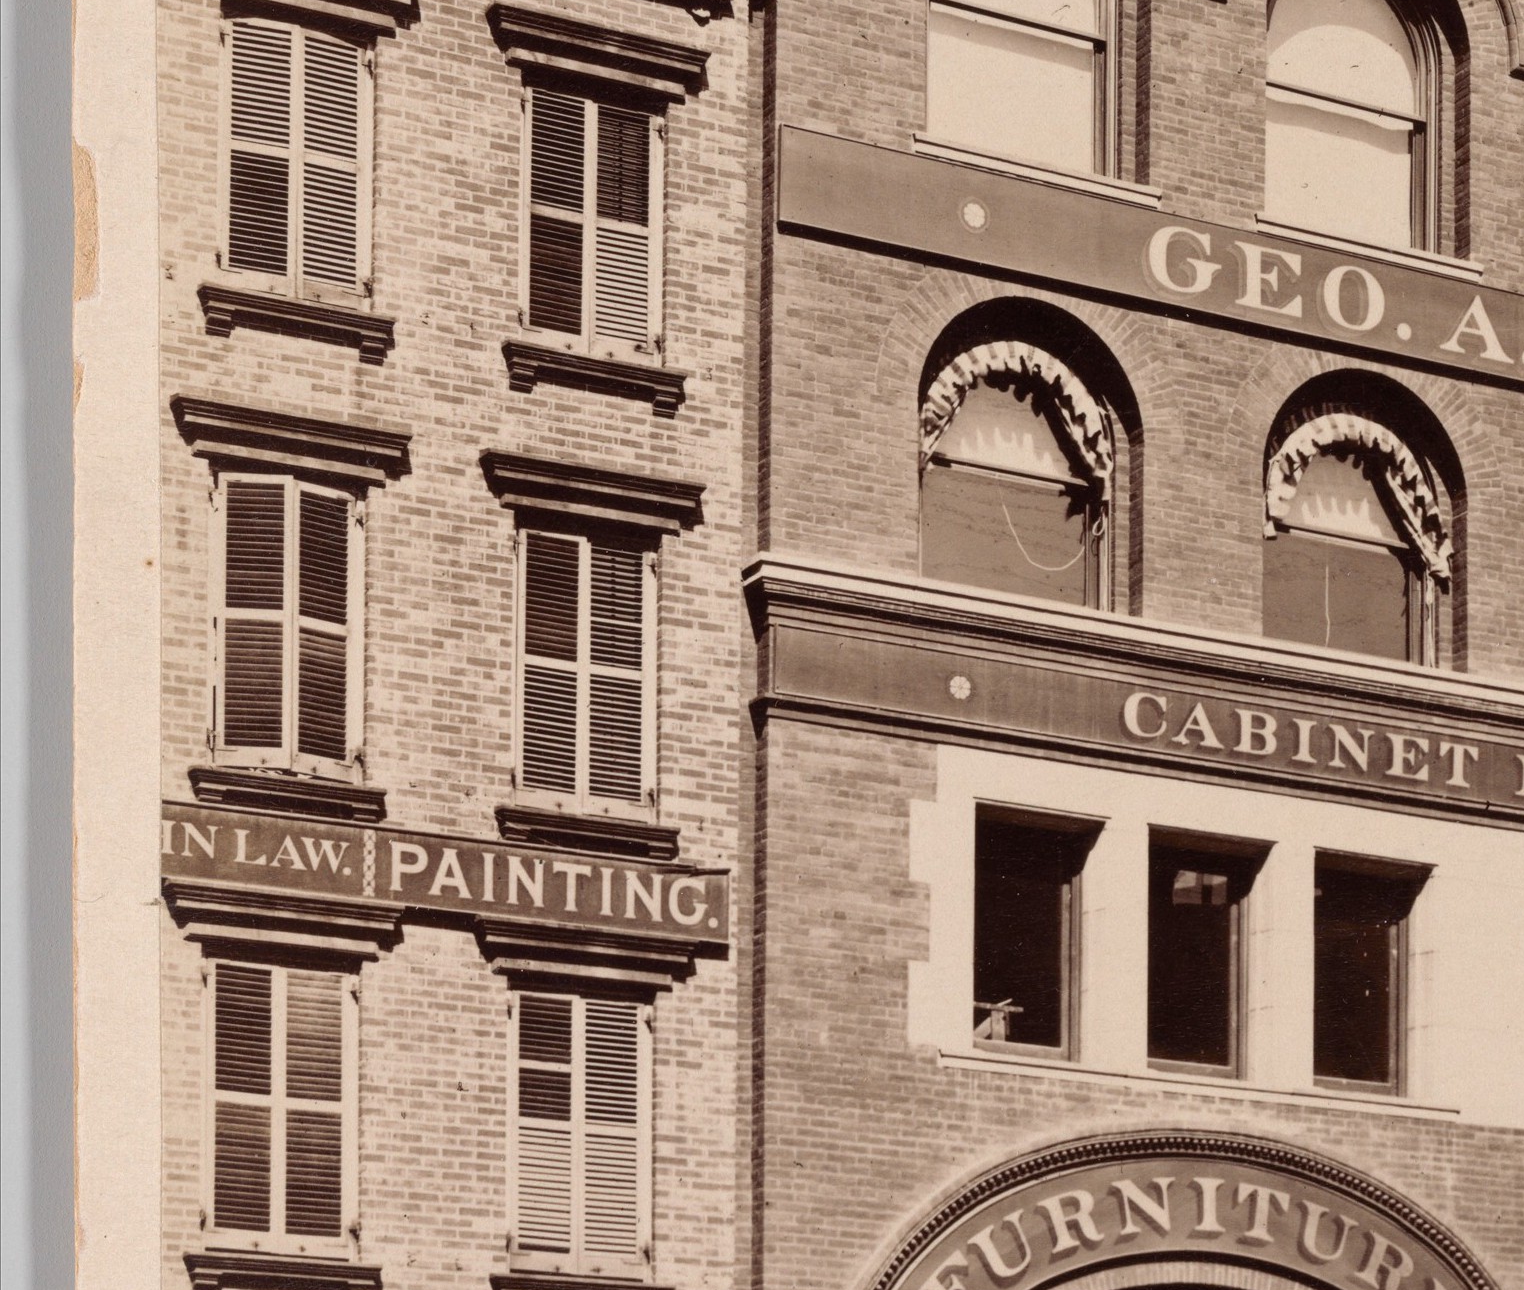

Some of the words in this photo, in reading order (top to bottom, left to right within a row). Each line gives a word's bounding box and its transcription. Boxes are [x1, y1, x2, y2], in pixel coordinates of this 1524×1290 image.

[1146, 225, 1412, 342] GEO.
[1123, 691, 1480, 790] CABINET
[233, 828, 353, 876] LAW.
[388, 840, 720, 929] PAINTING.
